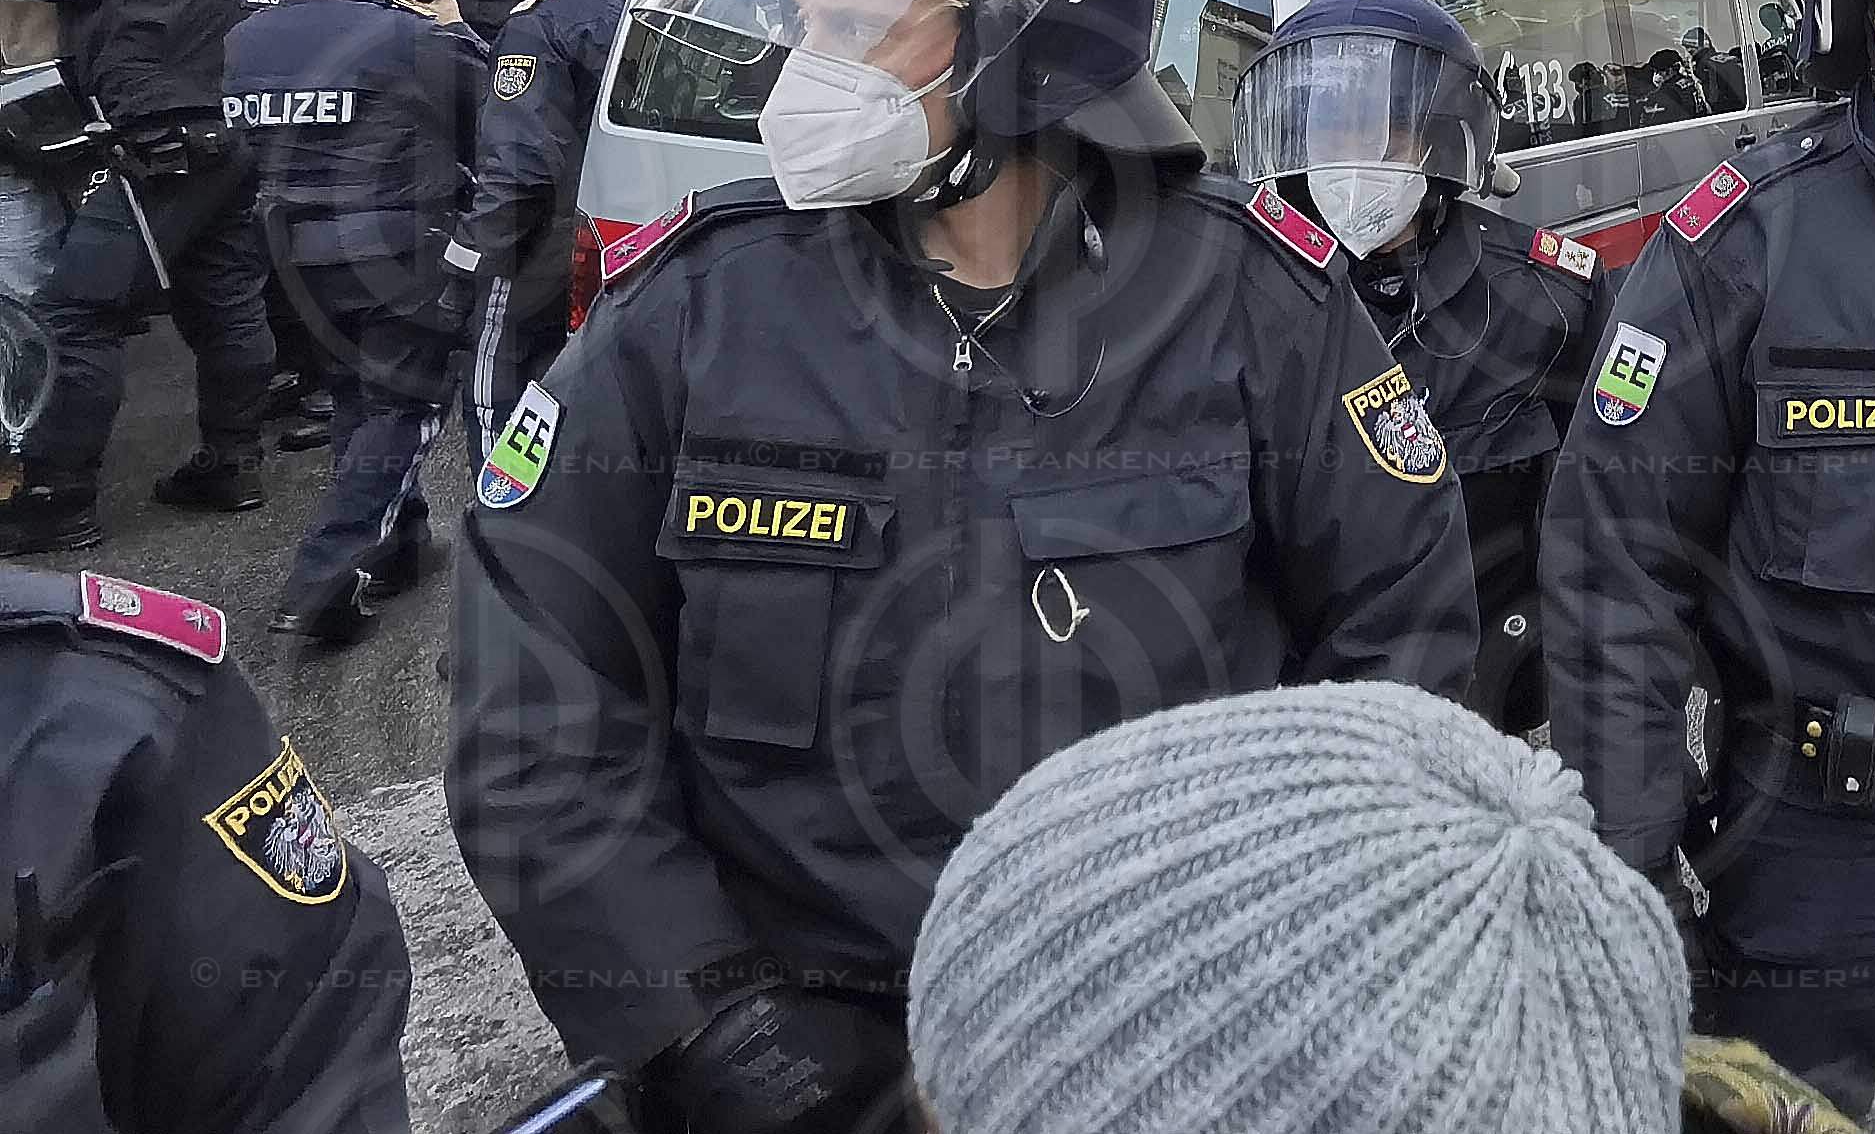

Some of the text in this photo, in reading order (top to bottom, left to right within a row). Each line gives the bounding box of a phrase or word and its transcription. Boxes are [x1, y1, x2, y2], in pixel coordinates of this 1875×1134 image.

[221, 90, 354, 128] POLIZEI
[1518, 59, 1567, 124] 133
[1608, 343, 1655, 390] EE
[506, 406, 551, 468] EE
[686, 494, 847, 542] POLIZEI
